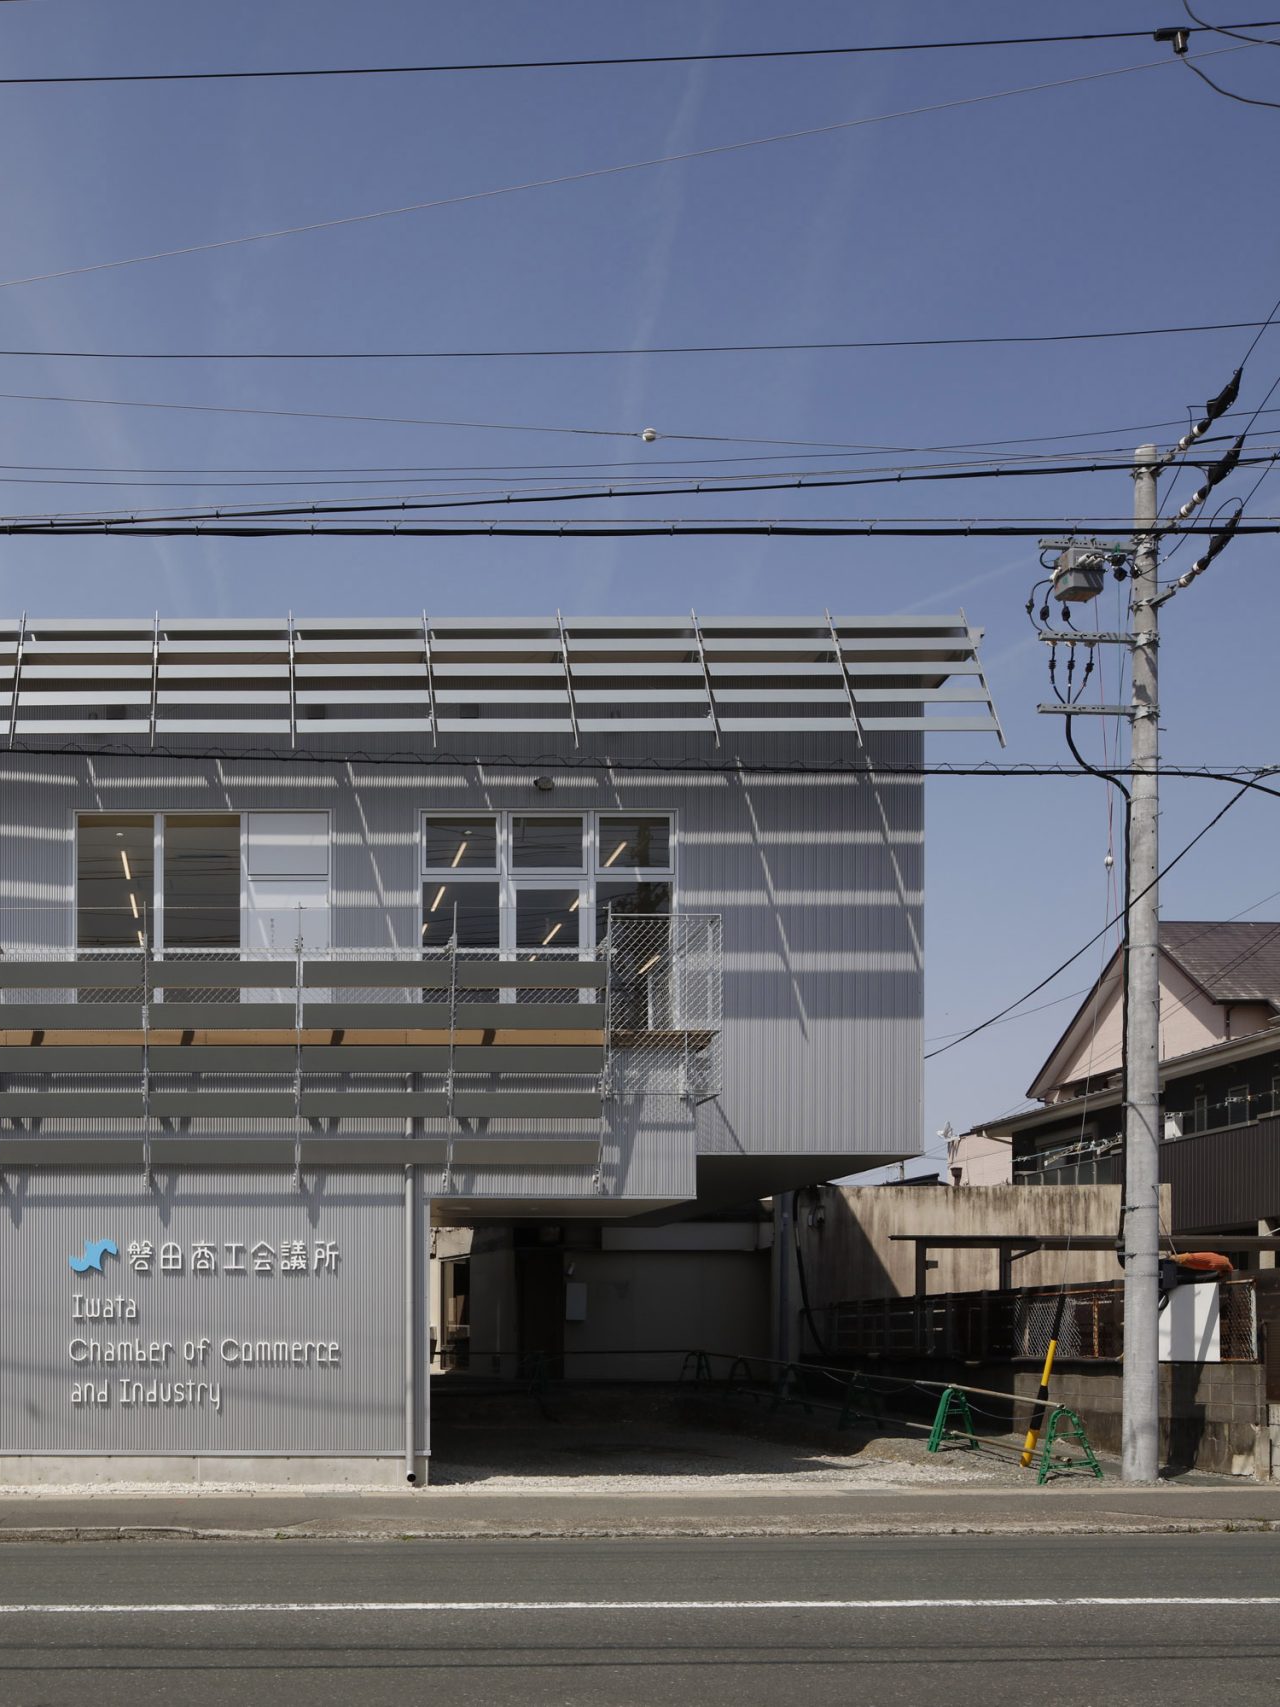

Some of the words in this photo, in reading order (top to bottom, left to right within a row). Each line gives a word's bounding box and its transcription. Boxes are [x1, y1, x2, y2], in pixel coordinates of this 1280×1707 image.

[128, 1240, 339, 1270] 磐田商工会議所
[72, 1294, 136, 1318] Iwata
[69, 1338, 172, 1361] Chamber
[183, 1338, 210, 1361] of
[220, 1338, 339, 1361] Commerce
[71, 1379, 108, 1402] and
[120, 1379, 221, 1410] Industry
